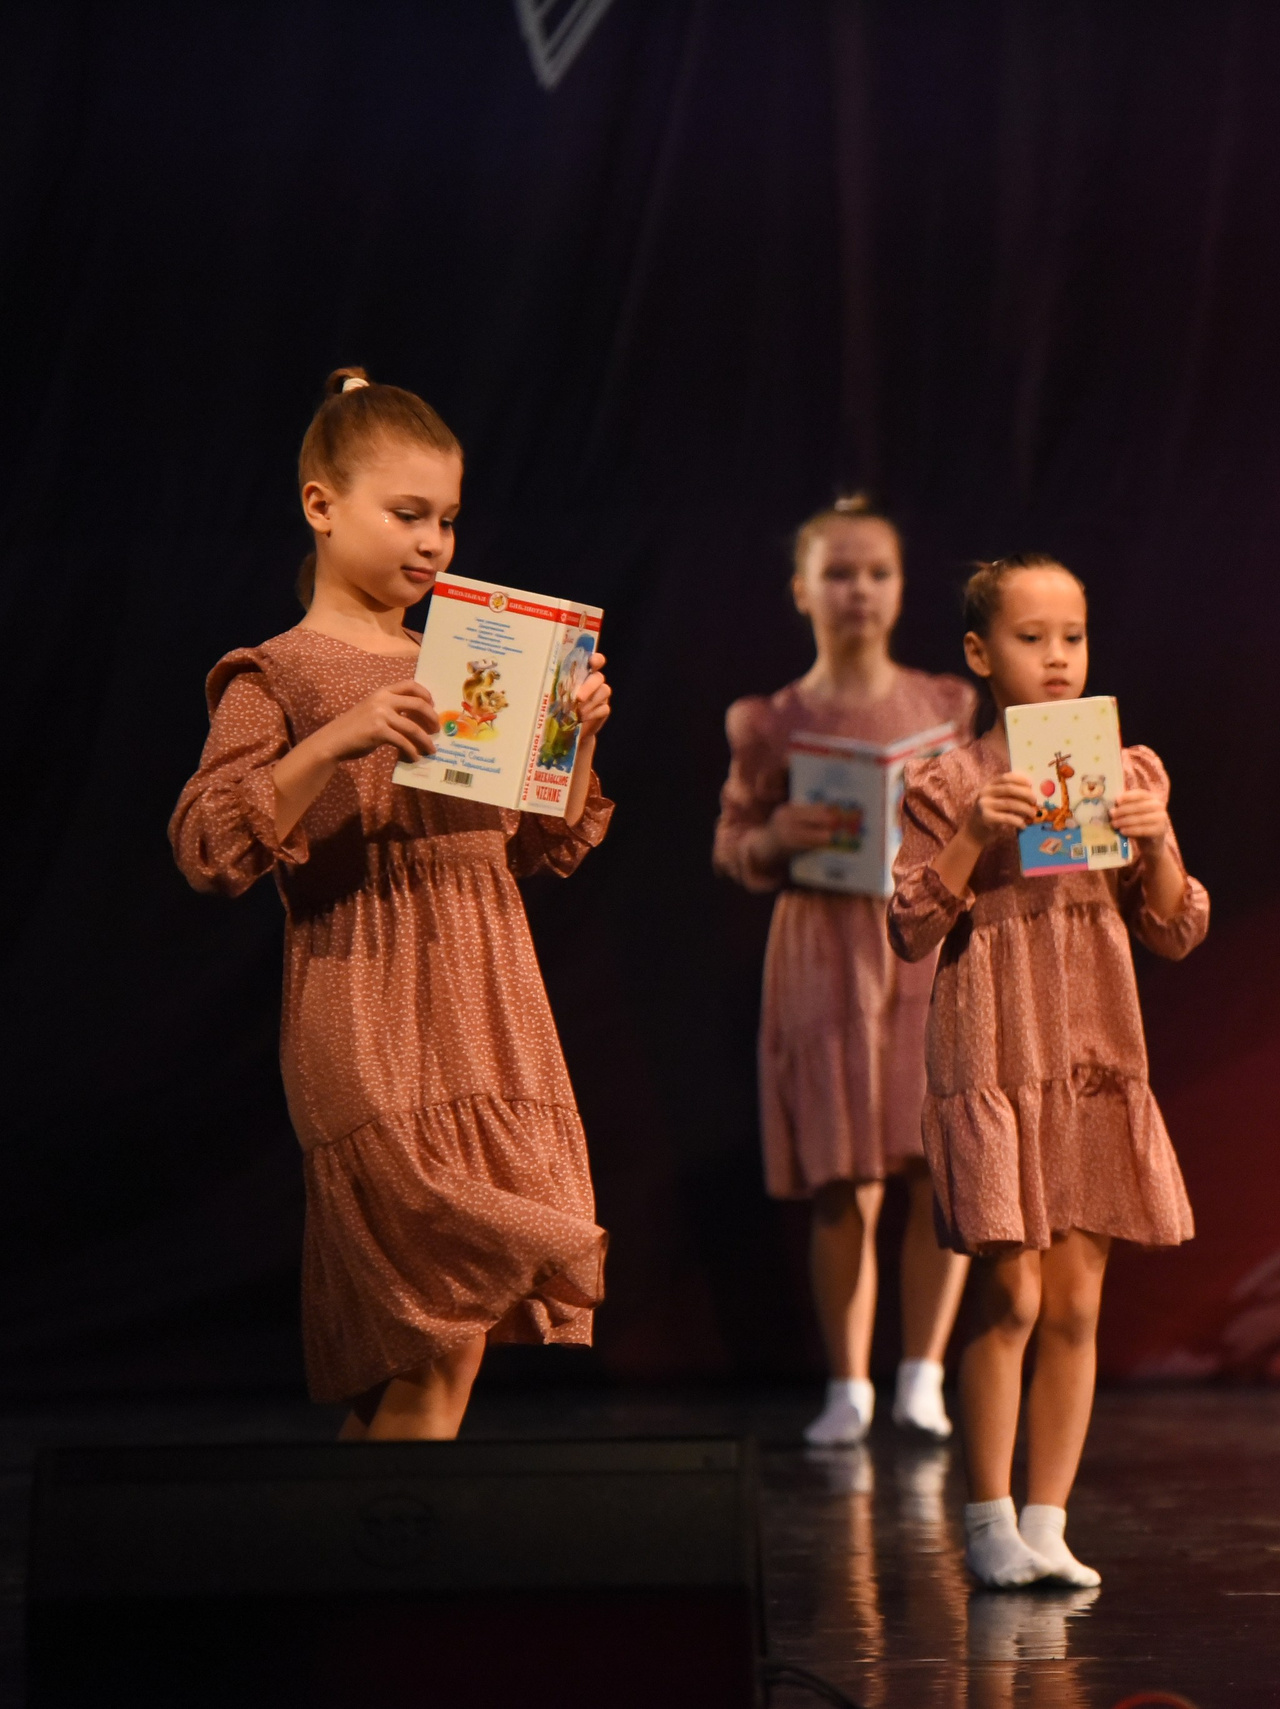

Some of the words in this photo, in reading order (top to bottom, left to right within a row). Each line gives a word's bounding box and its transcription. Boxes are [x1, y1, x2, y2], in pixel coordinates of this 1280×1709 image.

[447, 588, 487, 603] ШКОЛЬНАЯ
[509, 602, 554, 618] БИБЛИОТЕКА
[521, 735, 540, 801] ВНЕКЛАССНОЕ
[536, 693, 549, 729] ЧТЕНИЕ
[533, 770, 570, 787] ВНЕКЛАССНОЕ
[535, 785, 562, 803] ЧТЕНИЕ
